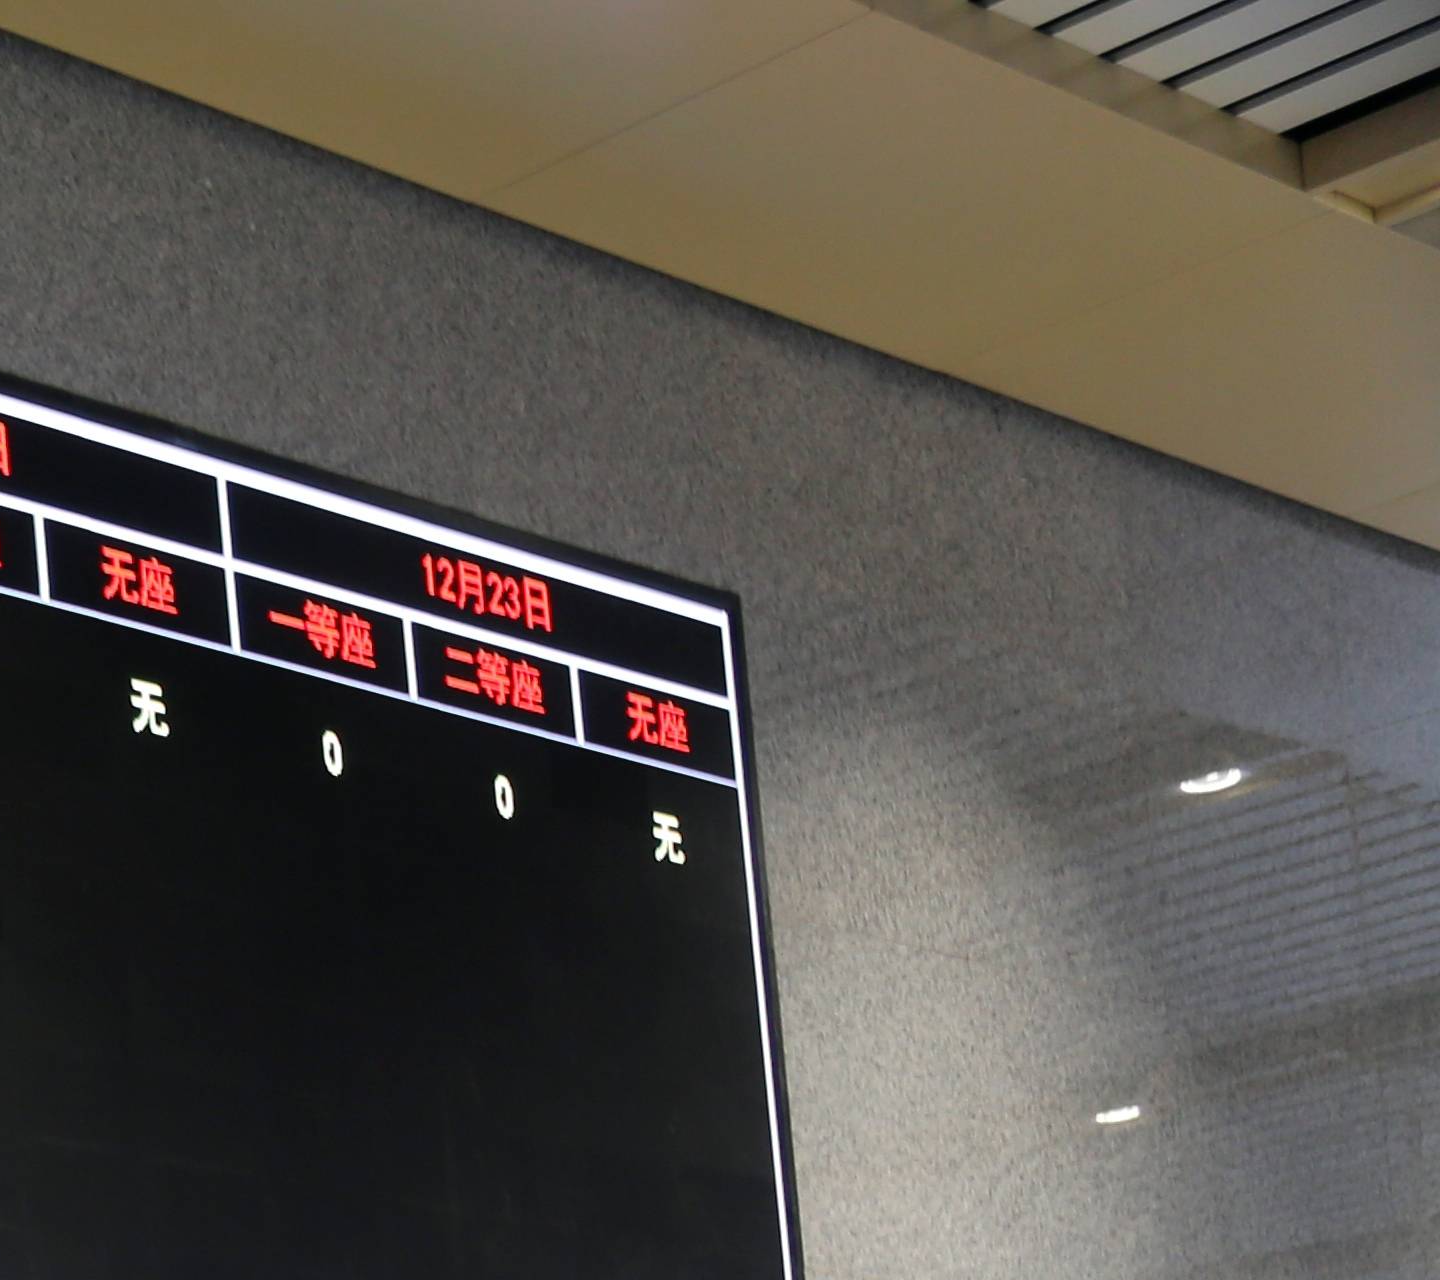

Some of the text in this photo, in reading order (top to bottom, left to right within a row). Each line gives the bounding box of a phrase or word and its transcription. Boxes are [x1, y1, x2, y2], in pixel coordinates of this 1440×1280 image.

[101, 546, 178, 614] 无座
[422, 555, 552, 632] 12月23日
[269, 601, 376, 668] 一等座
[131, 679, 169, 736] 无
[445, 647, 545, 714] 二等座
[627, 692, 690, 752] 无座
[323, 731, 342, 776] 0
[495, 775, 513, 819] 0
[653, 812, 685, 864] 无
